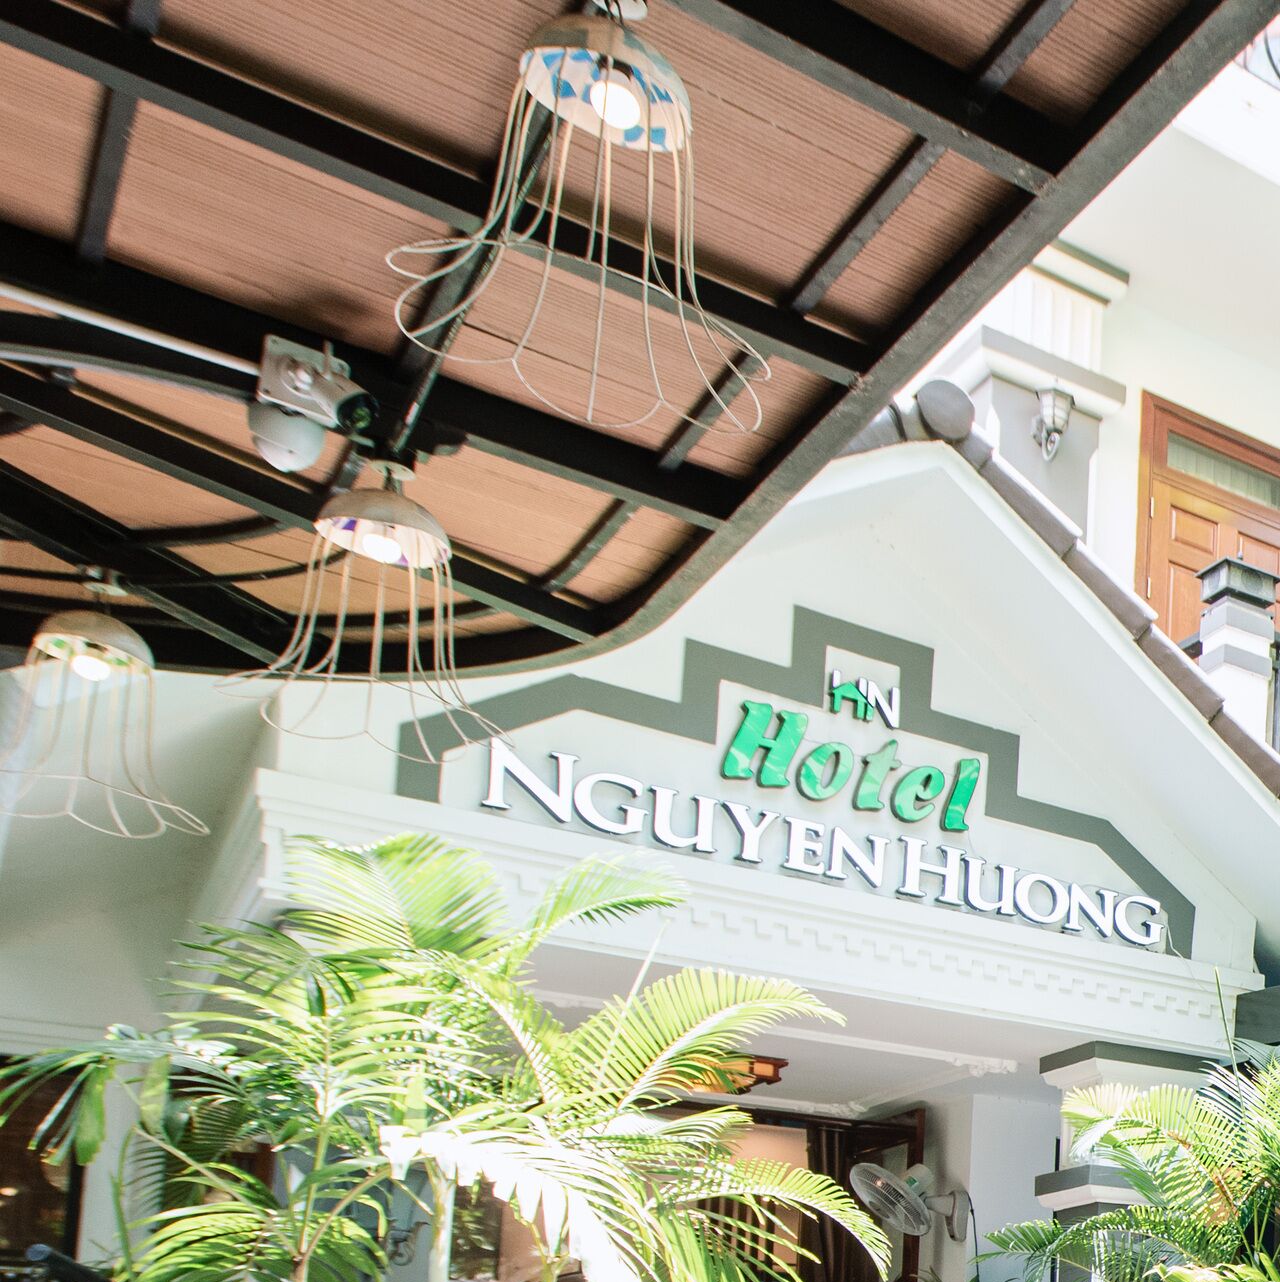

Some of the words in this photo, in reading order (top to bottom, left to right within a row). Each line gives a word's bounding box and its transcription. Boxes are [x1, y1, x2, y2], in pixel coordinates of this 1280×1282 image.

[481, 736, 892, 889] NGUYEN
[896, 834, 1165, 947] HUONG
[719, 699, 982, 833] Hotel
